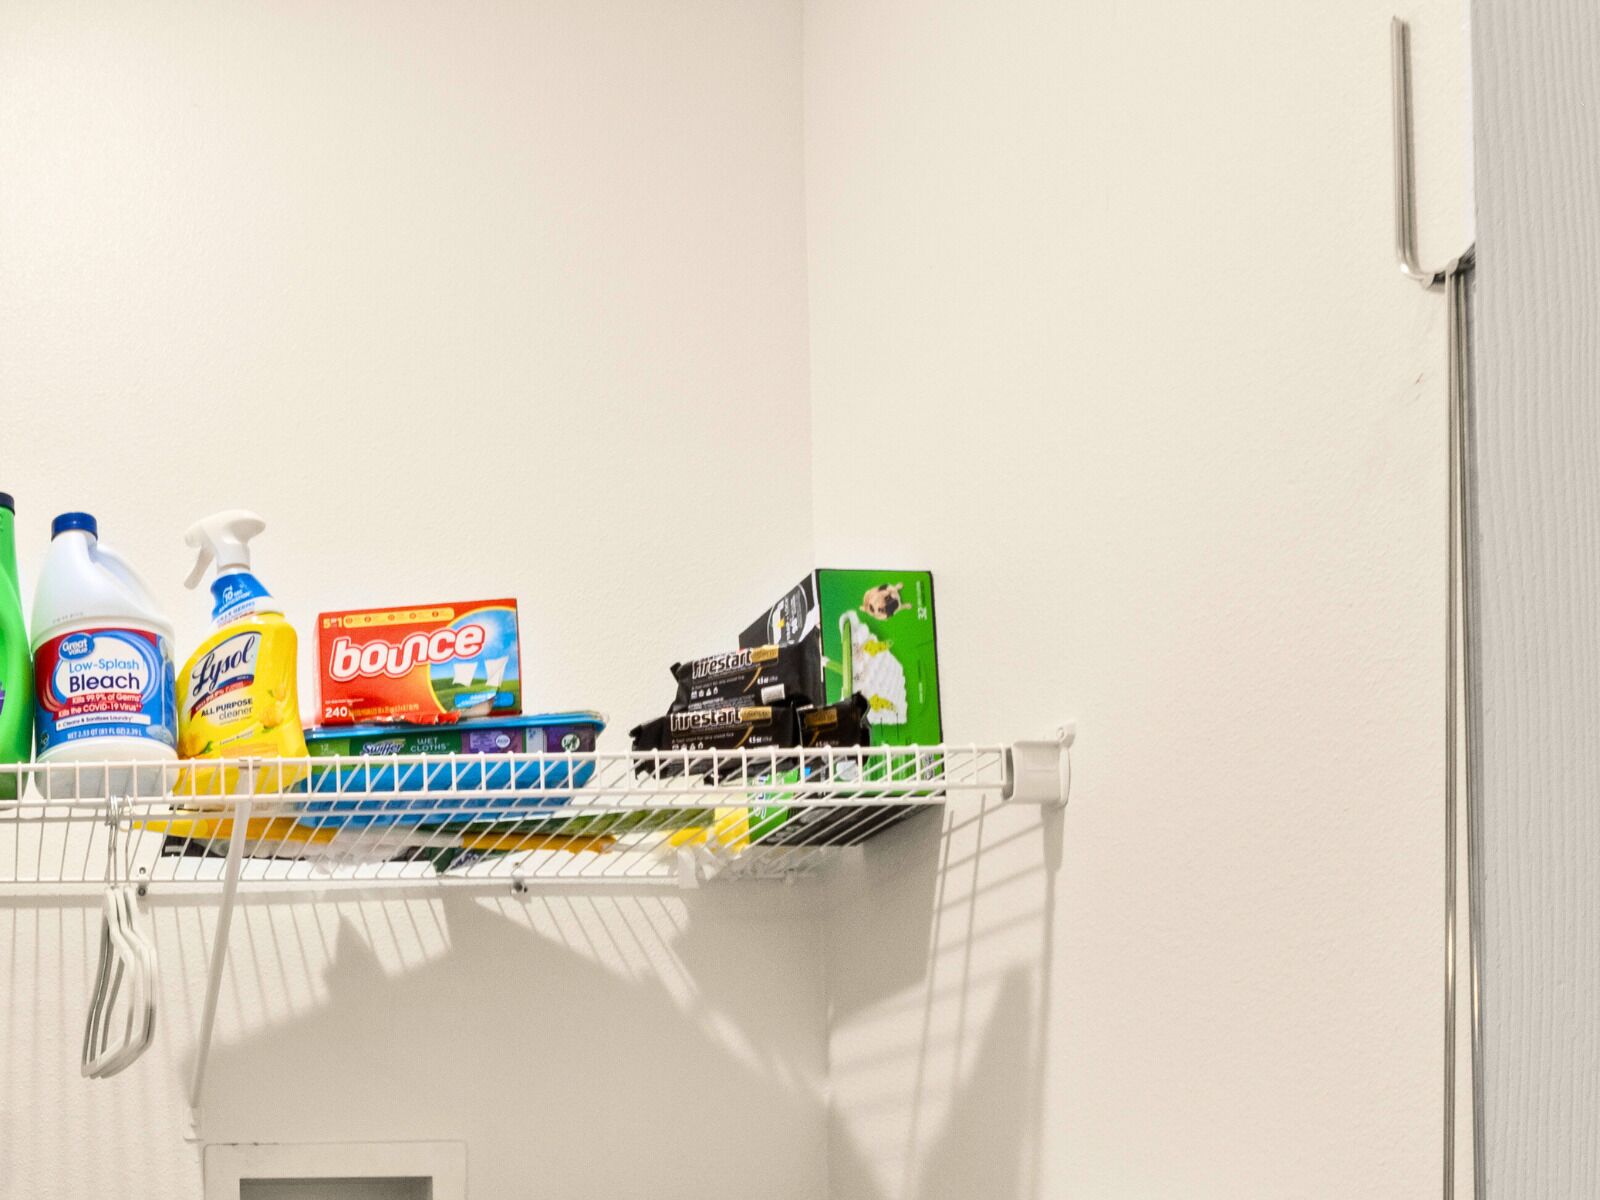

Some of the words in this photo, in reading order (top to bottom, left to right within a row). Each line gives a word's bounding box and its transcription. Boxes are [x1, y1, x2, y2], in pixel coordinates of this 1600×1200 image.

[62, 639, 88, 652] Great
[331, 627, 483, 678] bounce
[69, 658, 140, 673] Low-Splash
[192, 635, 254, 696] Lysol
[69, 673, 140, 693] Bleach
[86, 694, 106, 703] 99.9%
[83, 703, 119, 713] COVID-19
[201, 708, 216, 717] ALL
[216, 698, 254, 713] PURPOSE
[219, 707, 253, 721] cleaner
[325, 706, 348, 718] 240
[670, 707, 742, 732] firestart
[411, 743, 447, 752] CLOTHS
